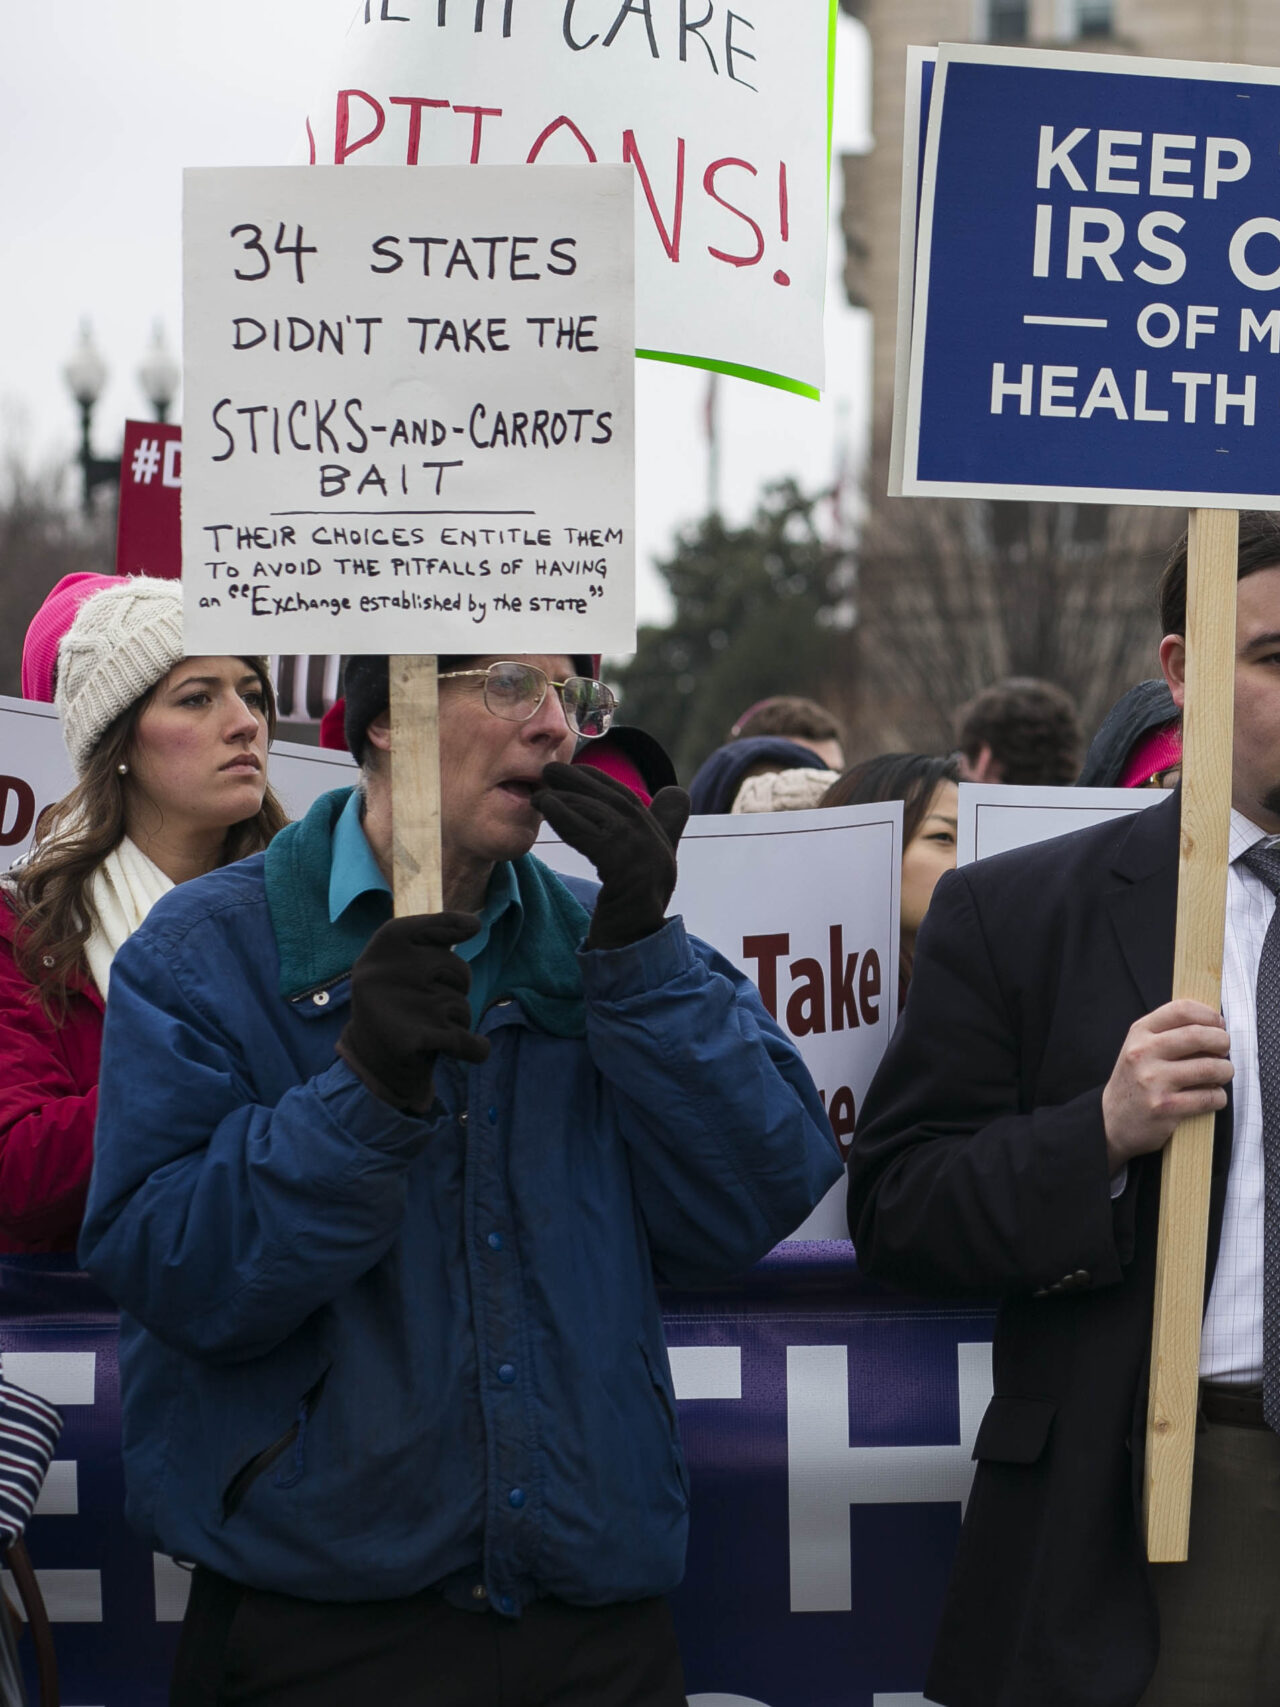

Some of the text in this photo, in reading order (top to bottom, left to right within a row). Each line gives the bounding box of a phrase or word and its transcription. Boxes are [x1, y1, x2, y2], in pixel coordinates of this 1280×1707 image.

[306, 88, 791, 287] PTNS!
[1036, 125, 1251, 200] KEEP
[230, 222, 577, 284] 34 STATES
[1033, 204, 1187, 285] IRS
[232, 315, 599, 355] DIDN'T TAKE THE
[1136, 302, 1219, 350] OF
[990, 362, 1257, 426] HEALTH
[211, 398, 614, 462] STICKS-AND-CARROTS
[319, 460, 464, 498] BAIT
[203, 524, 624, 553] THEIR CHOICES ENTITLE THEM
[204, 557, 608, 580] TO AVOID THE PITFALLS OF HAVING
[199, 596, 221, 609] an
[468, 593, 487, 624] by
[492, 593, 522, 613] the
[742, 923, 882, 1038] Take
